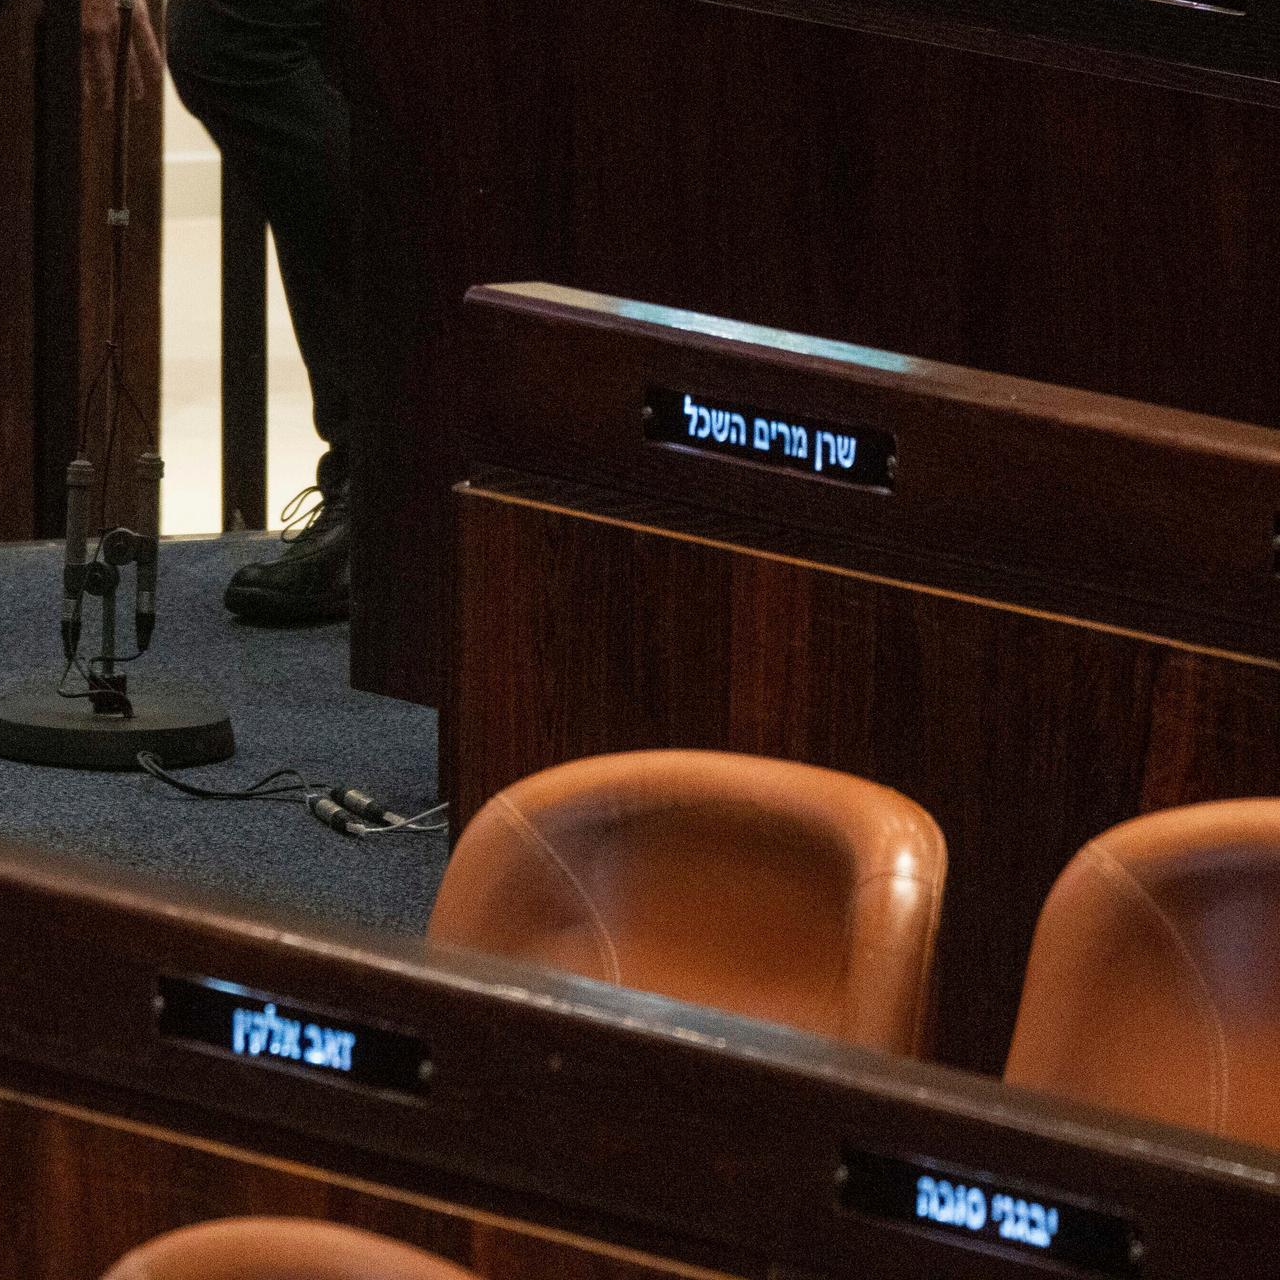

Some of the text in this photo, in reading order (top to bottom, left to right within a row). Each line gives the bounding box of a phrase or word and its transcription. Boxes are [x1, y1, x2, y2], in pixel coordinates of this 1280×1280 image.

[682, 394, 857, 472] שרן מרים השכל
